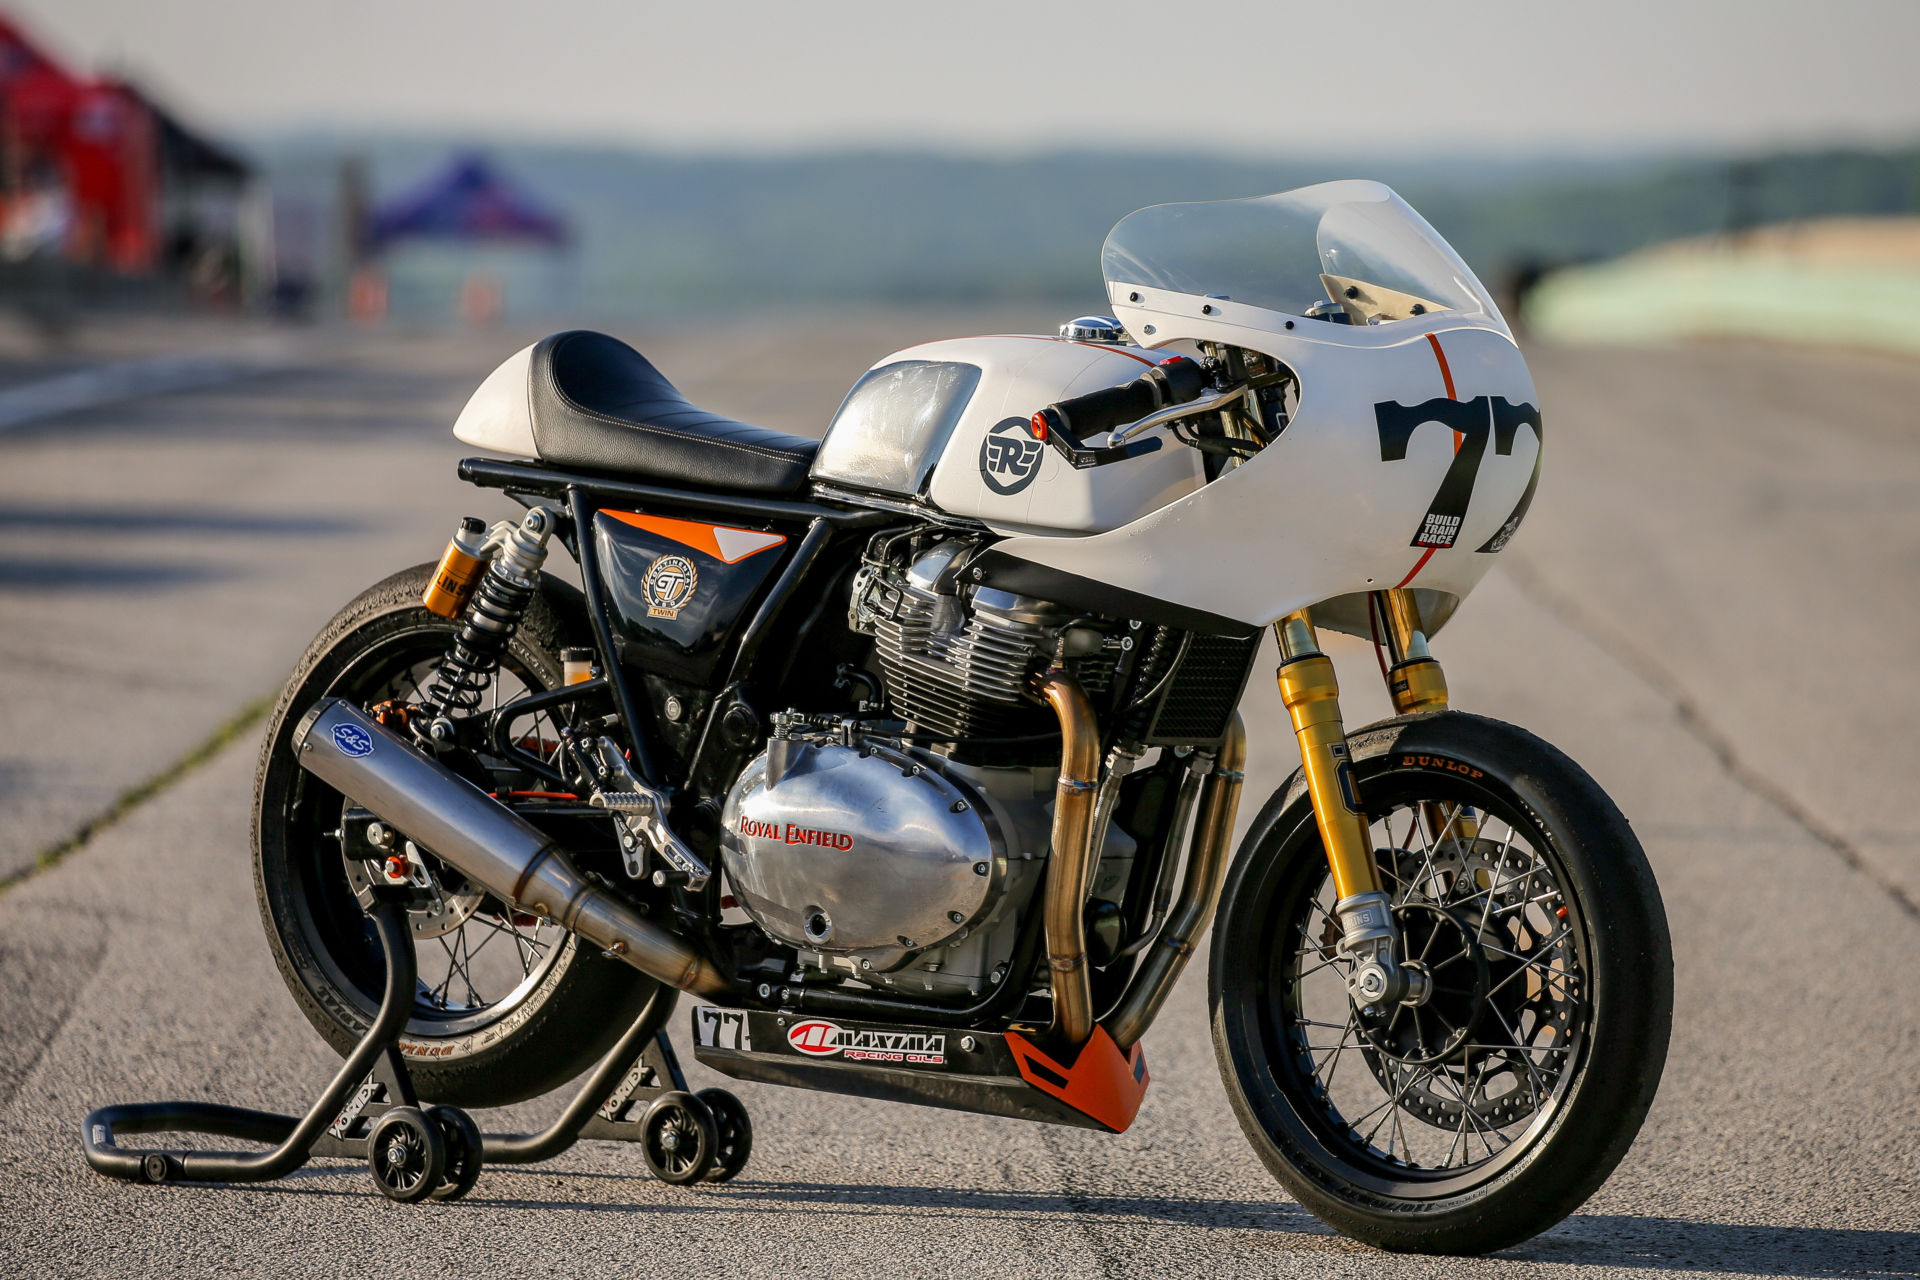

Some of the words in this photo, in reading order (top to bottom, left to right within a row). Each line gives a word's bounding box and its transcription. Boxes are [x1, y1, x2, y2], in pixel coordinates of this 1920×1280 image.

[1374, 395, 1544, 553] 77
[1423, 523, 1457, 536] TRAIN
[1426, 513, 1460, 527] BUILD
[1418, 532, 1453, 545] RACE
[436, 572, 467, 597] LINS
[649, 559, 690, 590] CONTINENTAL
[655, 571, 685, 601] GT
[652, 608, 675, 617] TWIN
[335, 728, 370, 751] S&S
[1402, 756, 1484, 779] DUNLOP
[740, 816, 782, 840] ROYAL
[785, 824, 854, 851] ENFIELD
[317, 985, 369, 1036] ADIAL
[703, 1010, 744, 1050] 77
[906, 1054, 944, 1064] OILS
[598, 1058, 650, 1121] VORTEX
[328, 1074, 380, 1139] VORTEX
